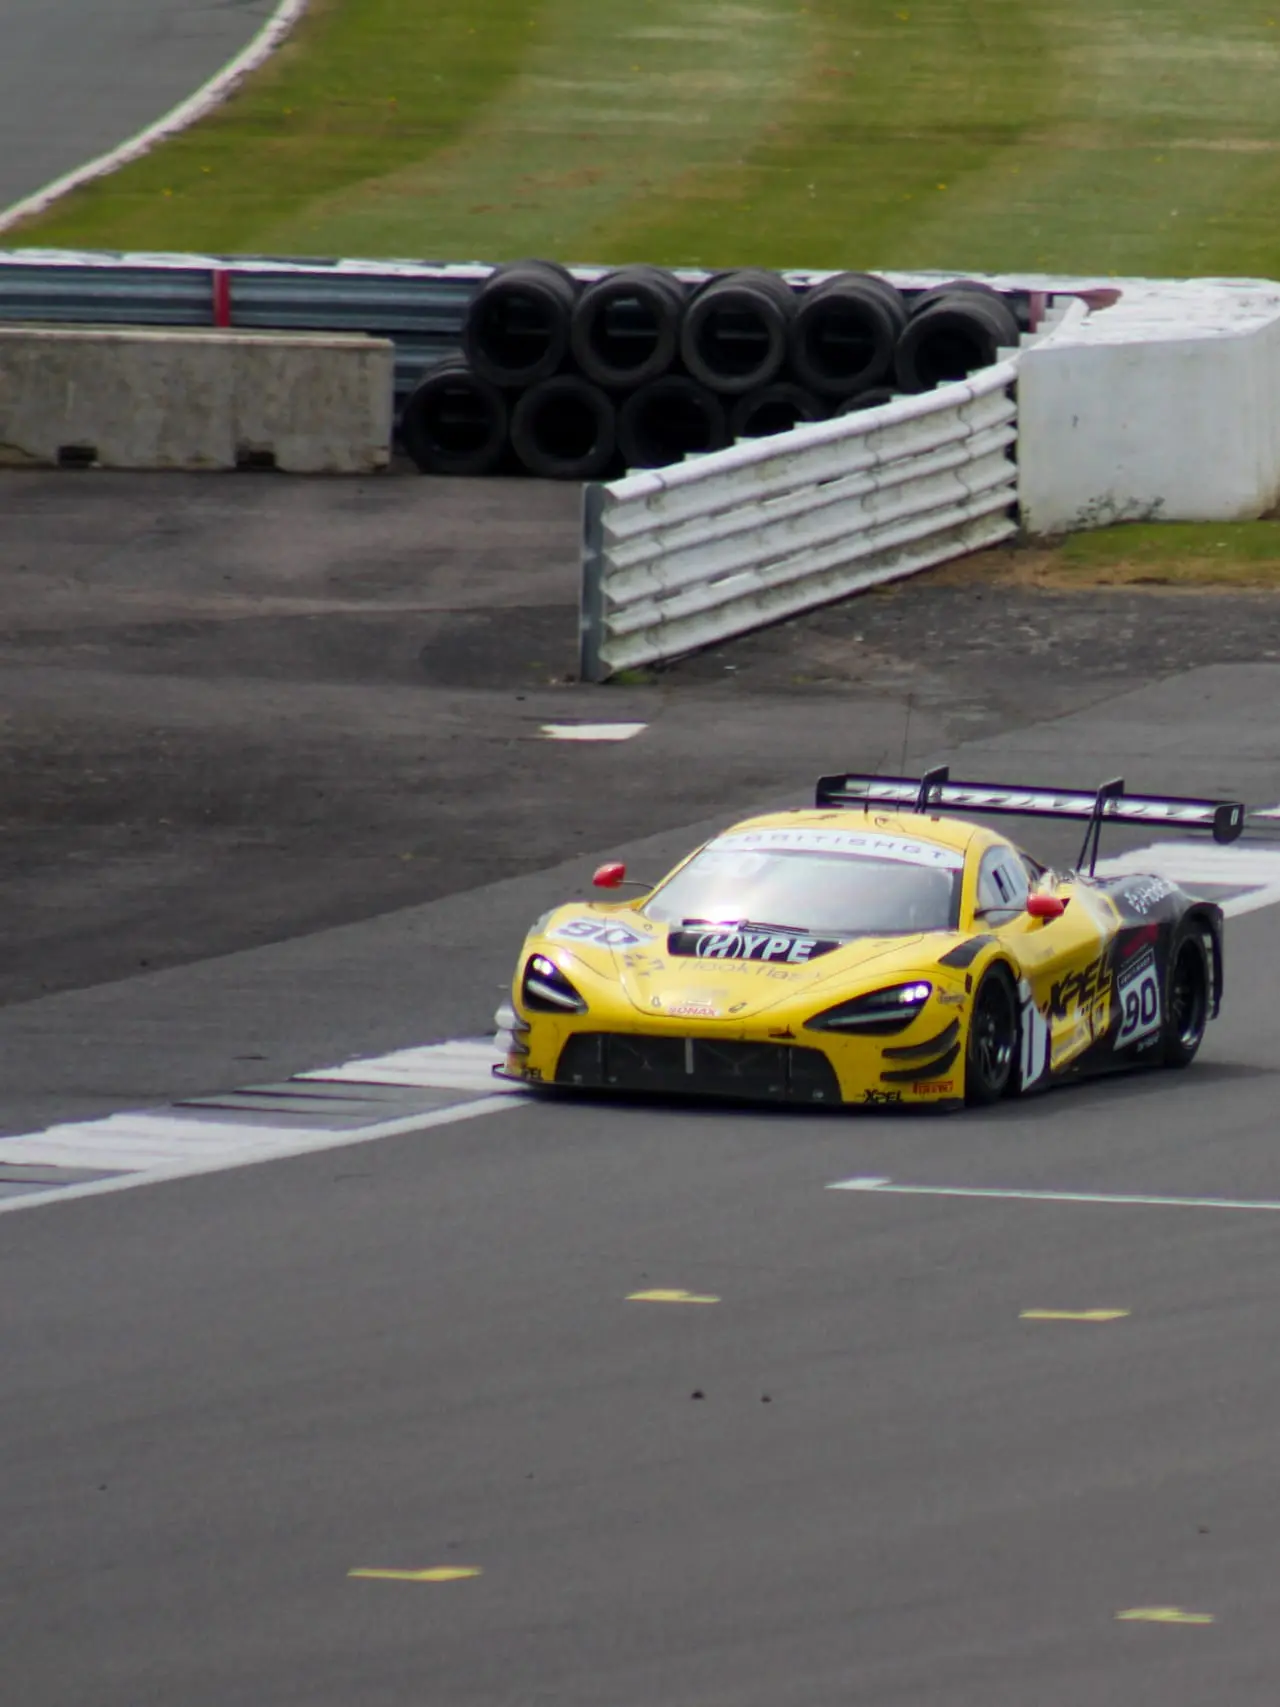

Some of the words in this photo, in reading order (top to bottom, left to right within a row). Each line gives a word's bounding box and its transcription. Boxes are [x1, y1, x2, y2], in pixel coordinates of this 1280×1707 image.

[556, 921, 640, 946] 90
[696, 932, 817, 963] HYPE
[1120, 977, 1157, 1038] 90
